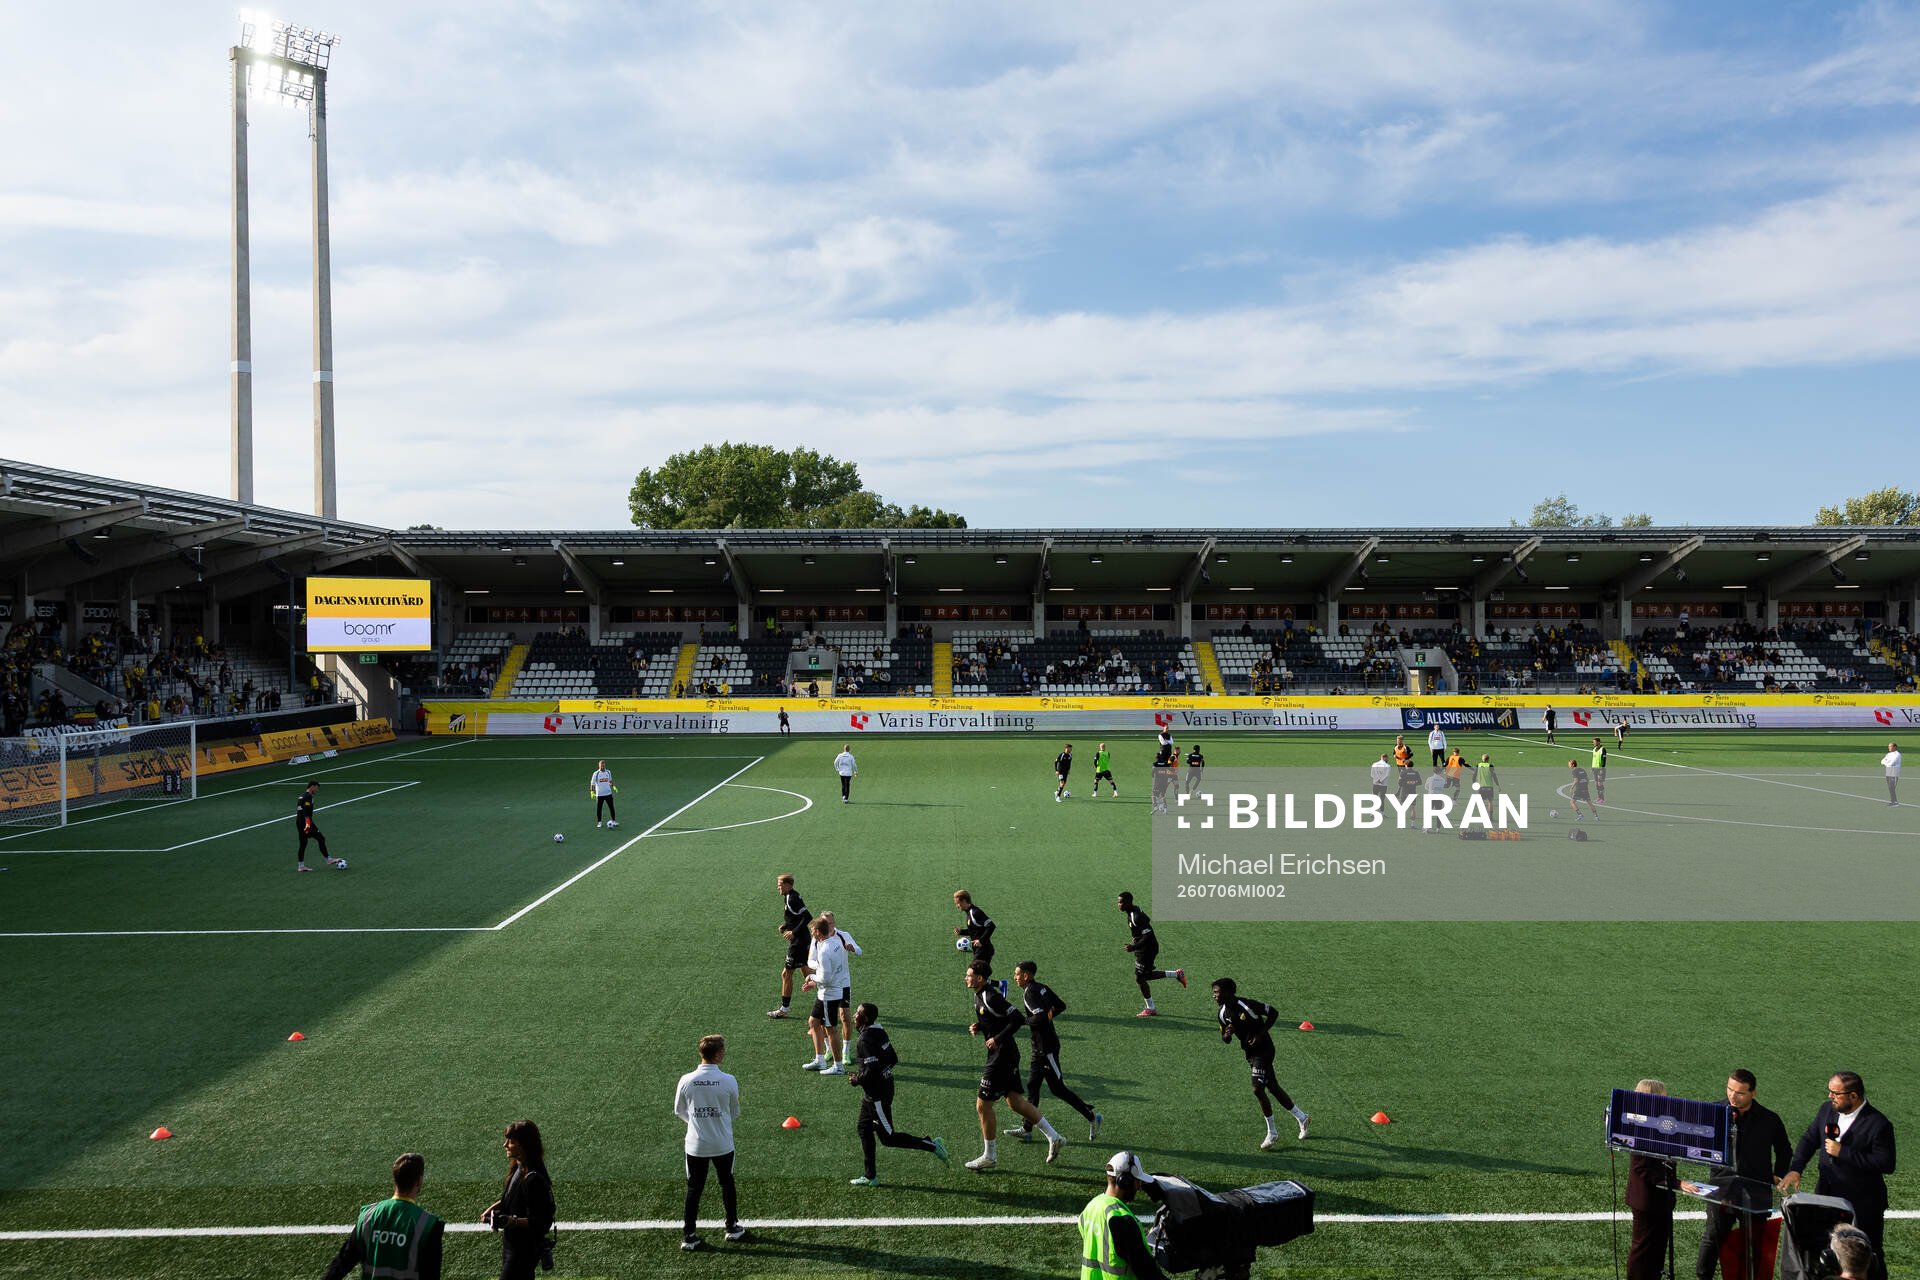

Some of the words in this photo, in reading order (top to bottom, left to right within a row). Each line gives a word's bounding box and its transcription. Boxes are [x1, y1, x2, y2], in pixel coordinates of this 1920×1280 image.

[314, 595, 356, 605] DAGENS
[358, 594, 424, 606] MATCHVÄRD
[344, 621, 396, 635] boomr
[573, 715, 617, 729] Varis
[622, 714, 730, 733] Förvaltning
[878, 712, 924, 727] Varis
[928, 712, 1034, 731] Förvaltning
[1182, 711, 1227, 726] Varis
[1232, 711, 1338, 729] Förvaltning
[1426, 712, 1494, 725] ALLSVENSKAN
[1599, 710, 1646, 724] Varis
[1649, 709, 1757, 728] Förvaltning
[372, 1230, 407, 1247] FOTO
